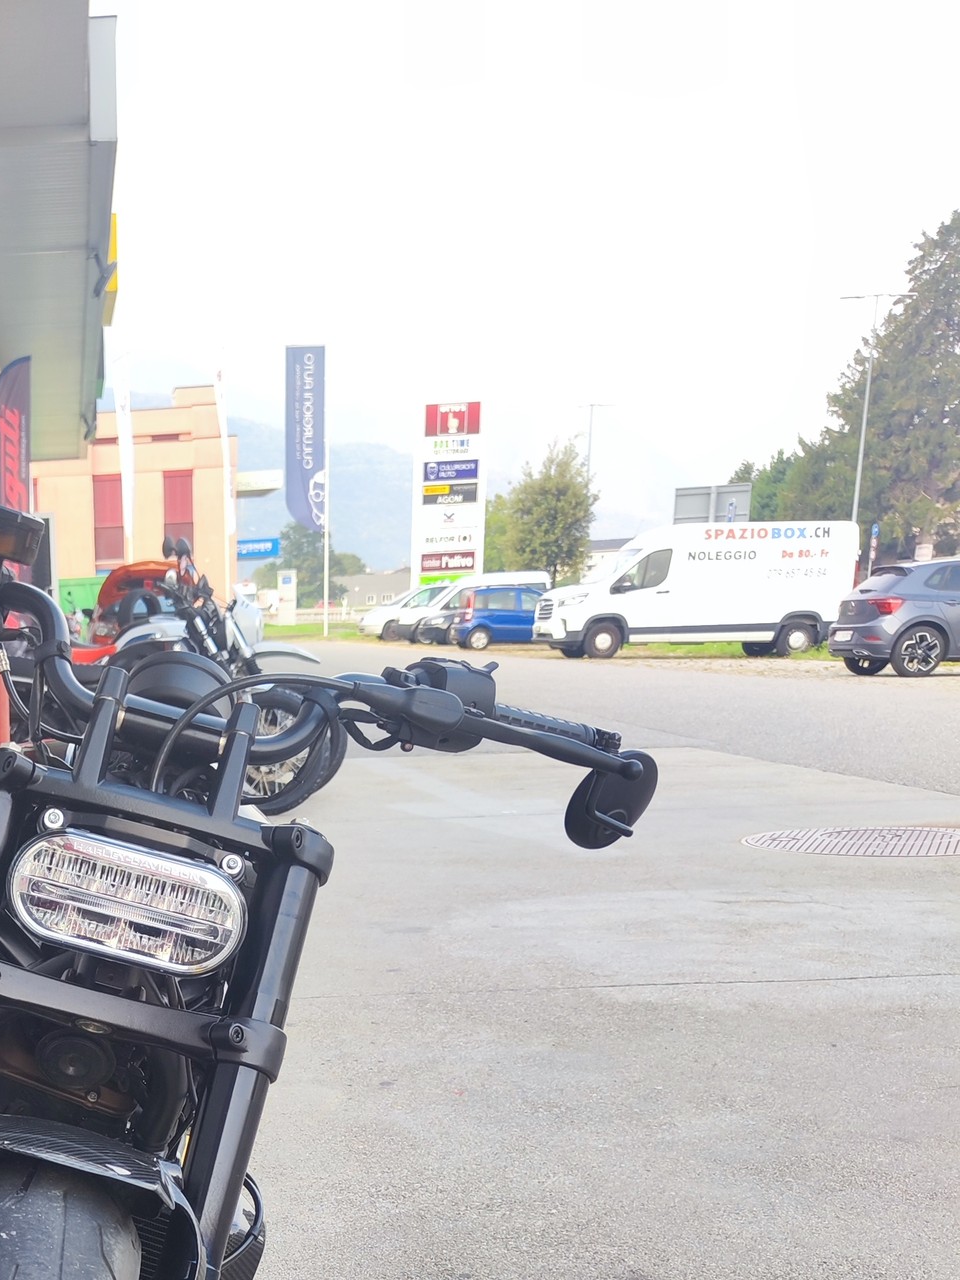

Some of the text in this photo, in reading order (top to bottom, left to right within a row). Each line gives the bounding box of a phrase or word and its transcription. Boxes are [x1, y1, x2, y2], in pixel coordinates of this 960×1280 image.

[704, 527, 831, 541] SPAZIOBOX.CH
[687, 550, 757, 561] NOLEGGIO
[781, 550, 794, 559] Da
[820, 549, 830, 558] Fr
